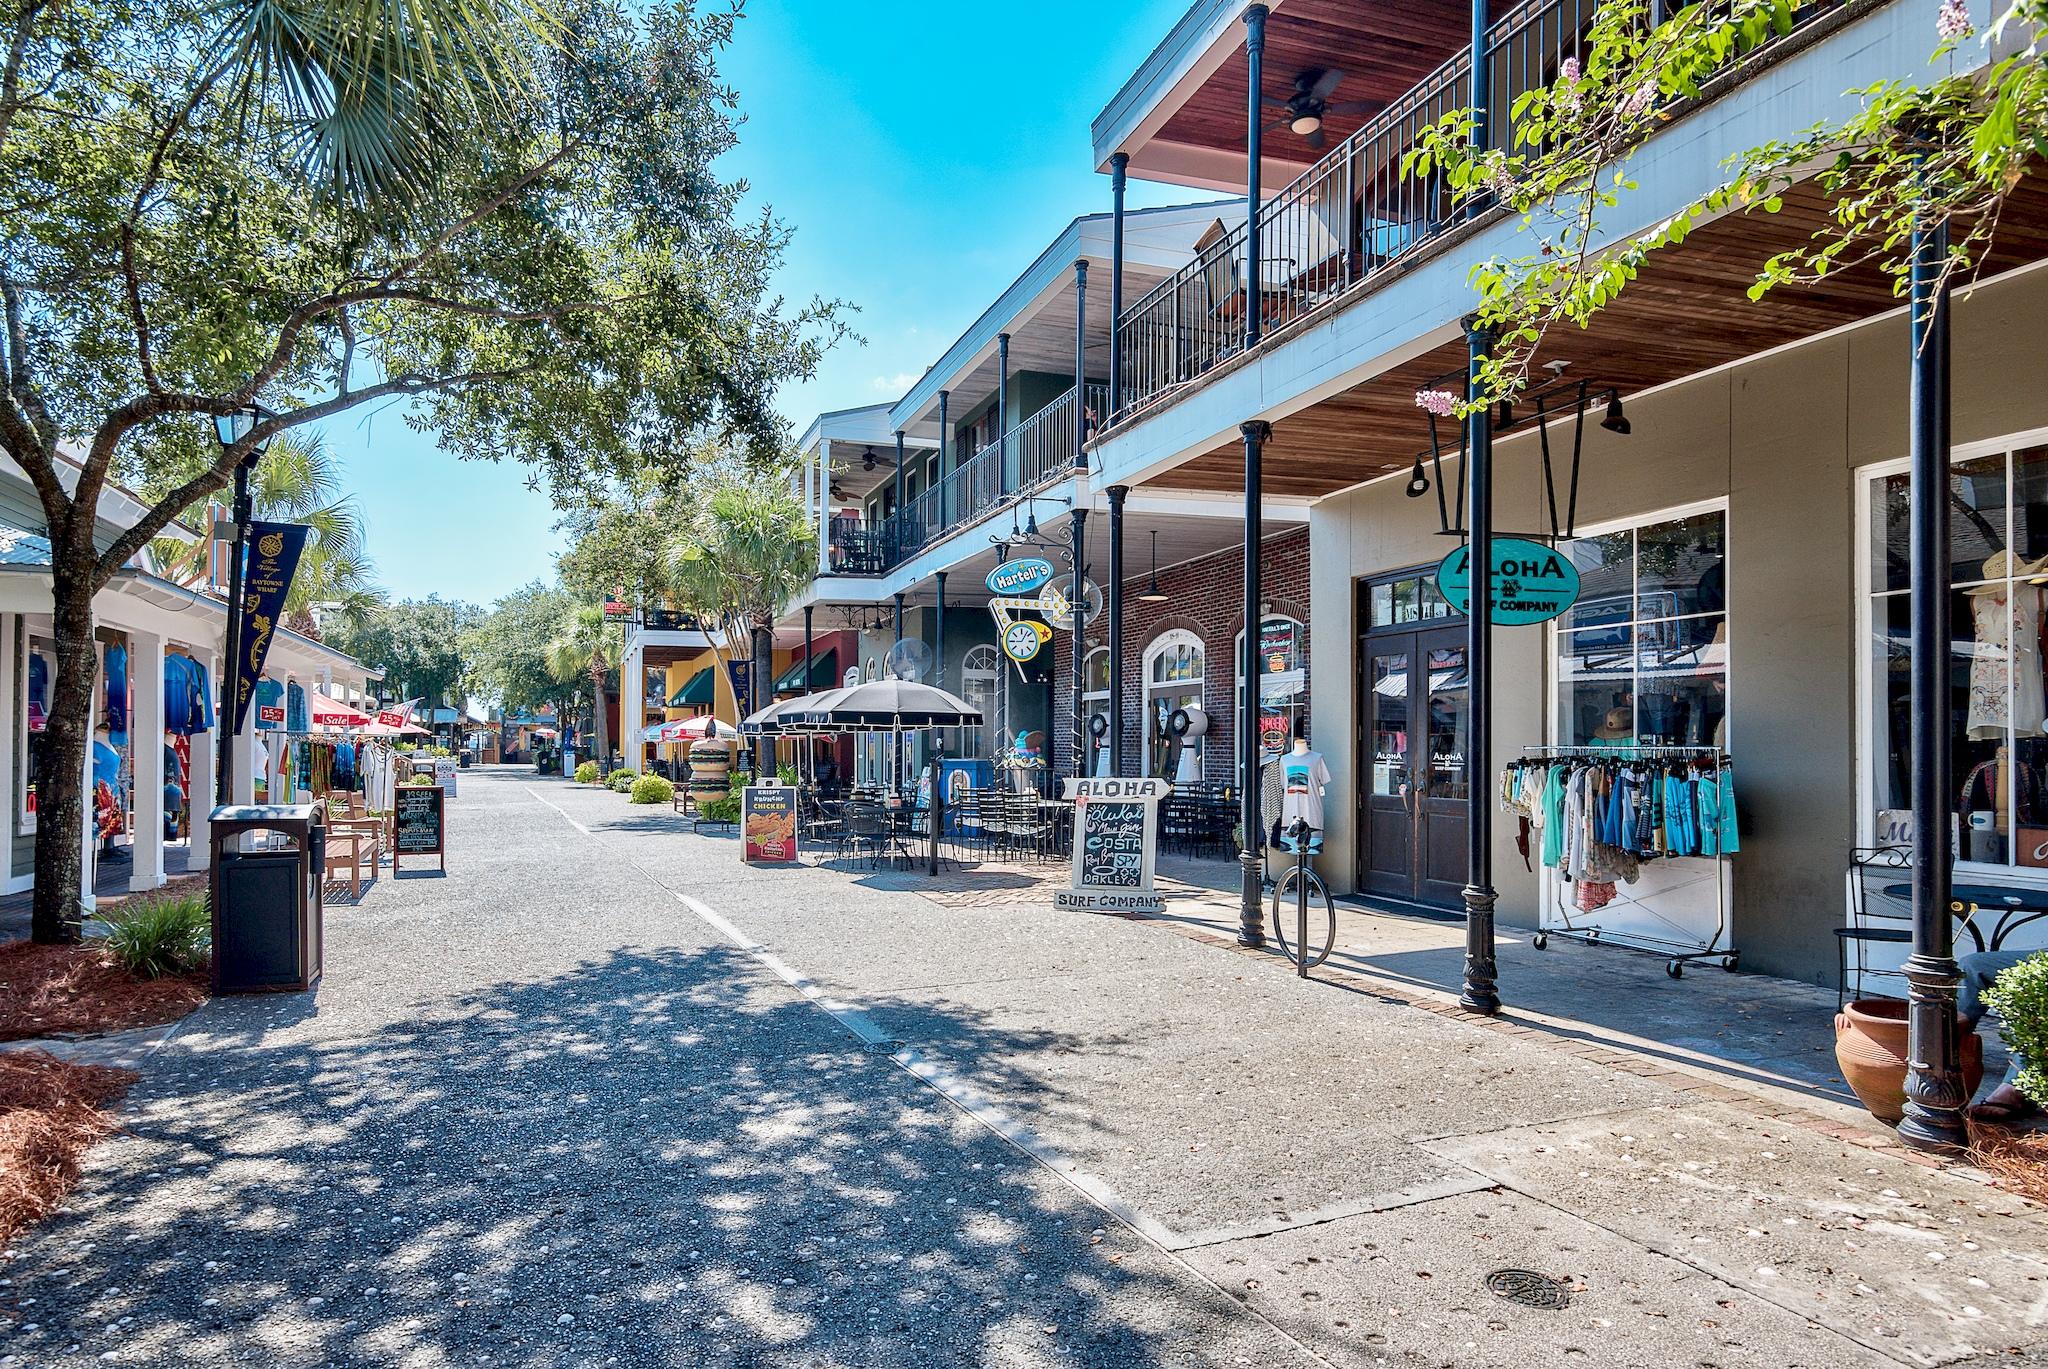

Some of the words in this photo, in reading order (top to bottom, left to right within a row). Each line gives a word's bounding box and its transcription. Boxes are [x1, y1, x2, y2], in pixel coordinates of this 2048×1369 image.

[1456, 552, 1565, 578] AOHA
[252, 579, 283, 587] BAYTOWNE
[1500, 600, 1559, 612] COMPANY
[324, 716, 348, 726] Sale
[1376, 752, 1402, 760] ALOHA
[1433, 752, 1463, 760] ALOHA
[1076, 780, 1156, 798] ALOHA
[1086, 837, 1142, 851] COSTA
[1084, 854, 1100, 867] Ray
[1116, 855, 1138, 867] SPY
[1084, 874, 1128, 885] OAKLEY
[1058, 894, 1096, 907] SURF
[1100, 895, 1161, 908] COMPANY
